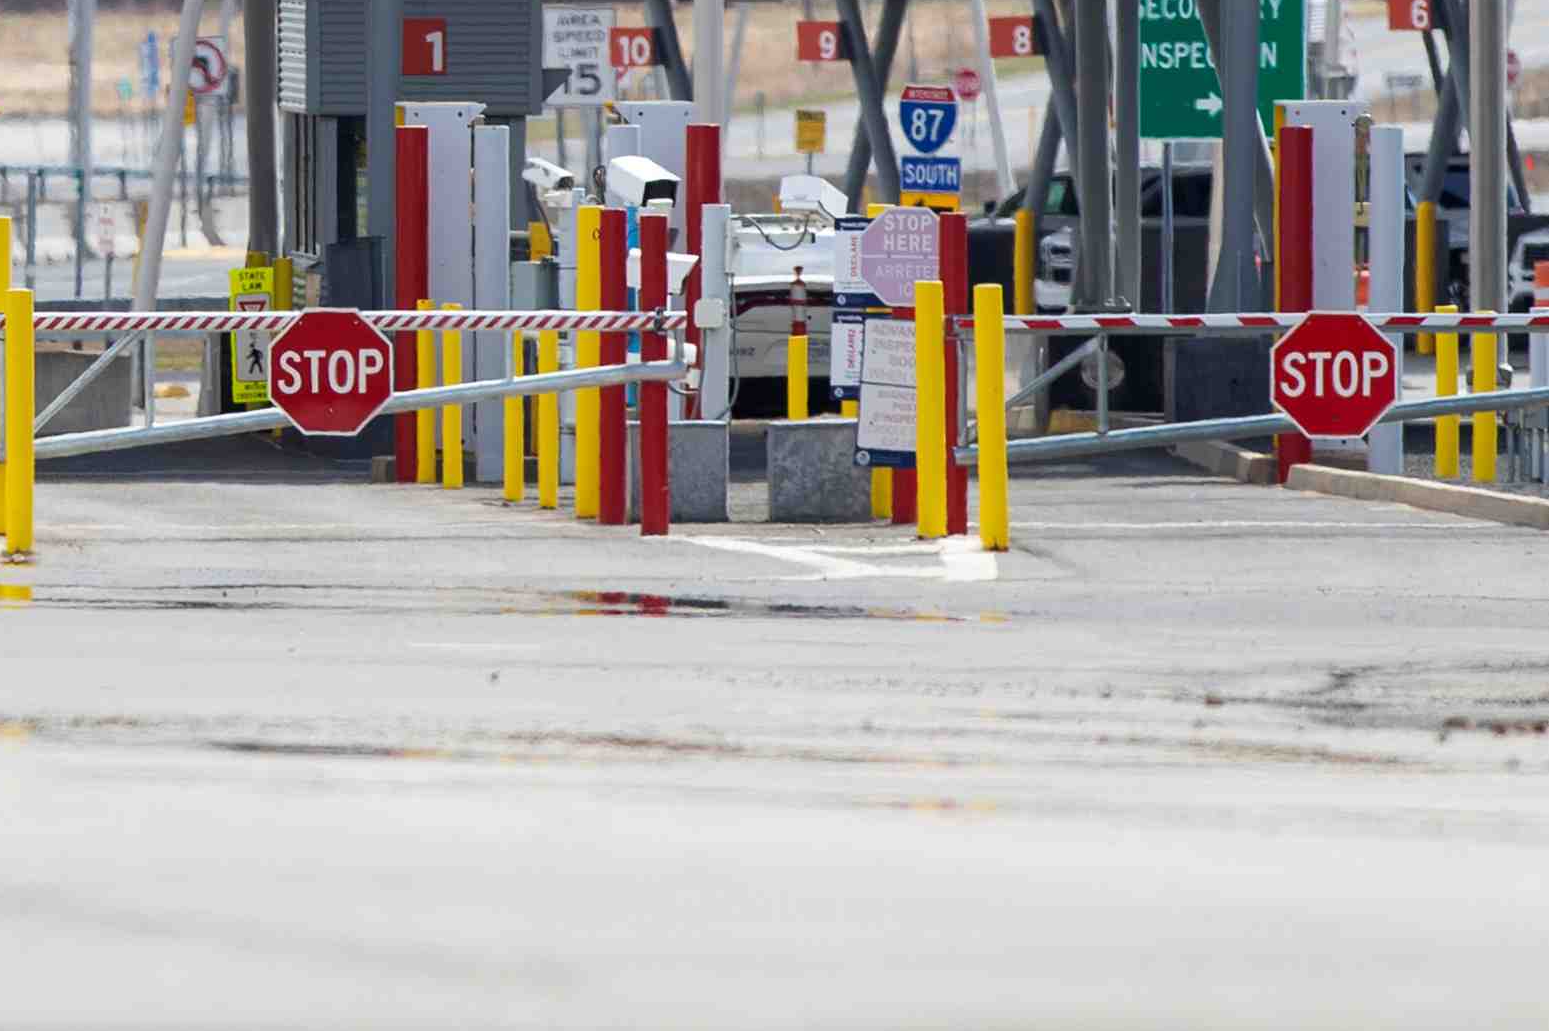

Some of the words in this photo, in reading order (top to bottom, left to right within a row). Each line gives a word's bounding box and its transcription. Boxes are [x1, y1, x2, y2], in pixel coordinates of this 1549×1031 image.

[425, 31, 442, 71] 1
[619, 36, 650, 64] 10
[819, 31, 836, 59] 9
[1014, 26, 1032, 54] 8
[912, 108, 945, 141] 87
[905, 164, 957, 185] SOUTH
[884, 214, 932, 231] STOP
[883, 234, 932, 251] HERE
[277, 348, 384, 394] STOP
[1281, 351, 1389, 398] STOP
